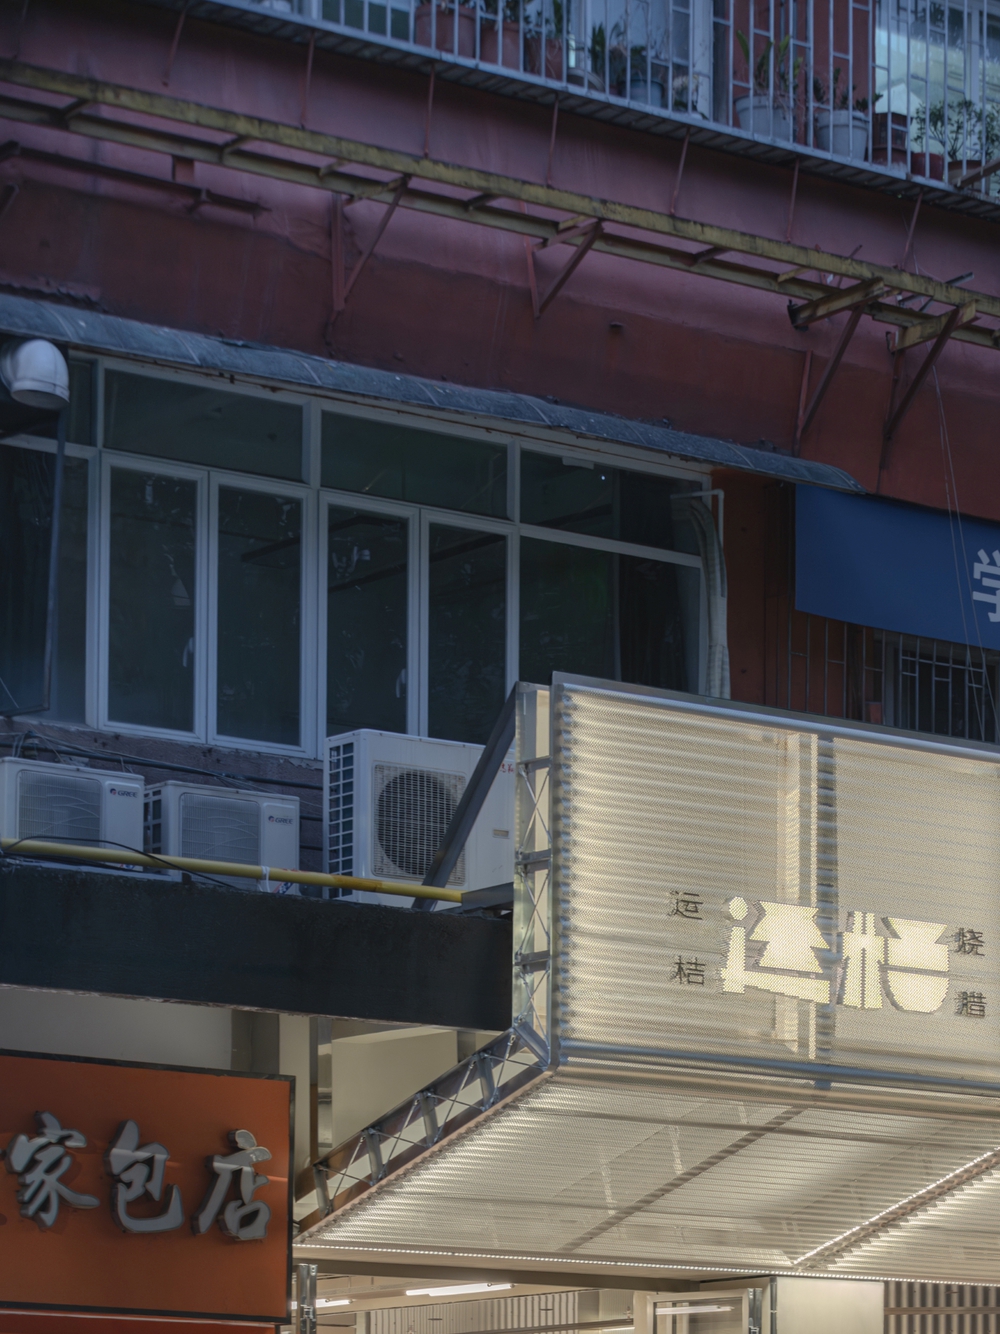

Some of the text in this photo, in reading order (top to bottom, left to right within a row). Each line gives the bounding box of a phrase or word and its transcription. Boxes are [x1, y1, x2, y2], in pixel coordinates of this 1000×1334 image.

[117, 790, 139, 798] GREE
[274, 817, 294, 825] GREE
[2, 1110, 273, 1241] 家包店
